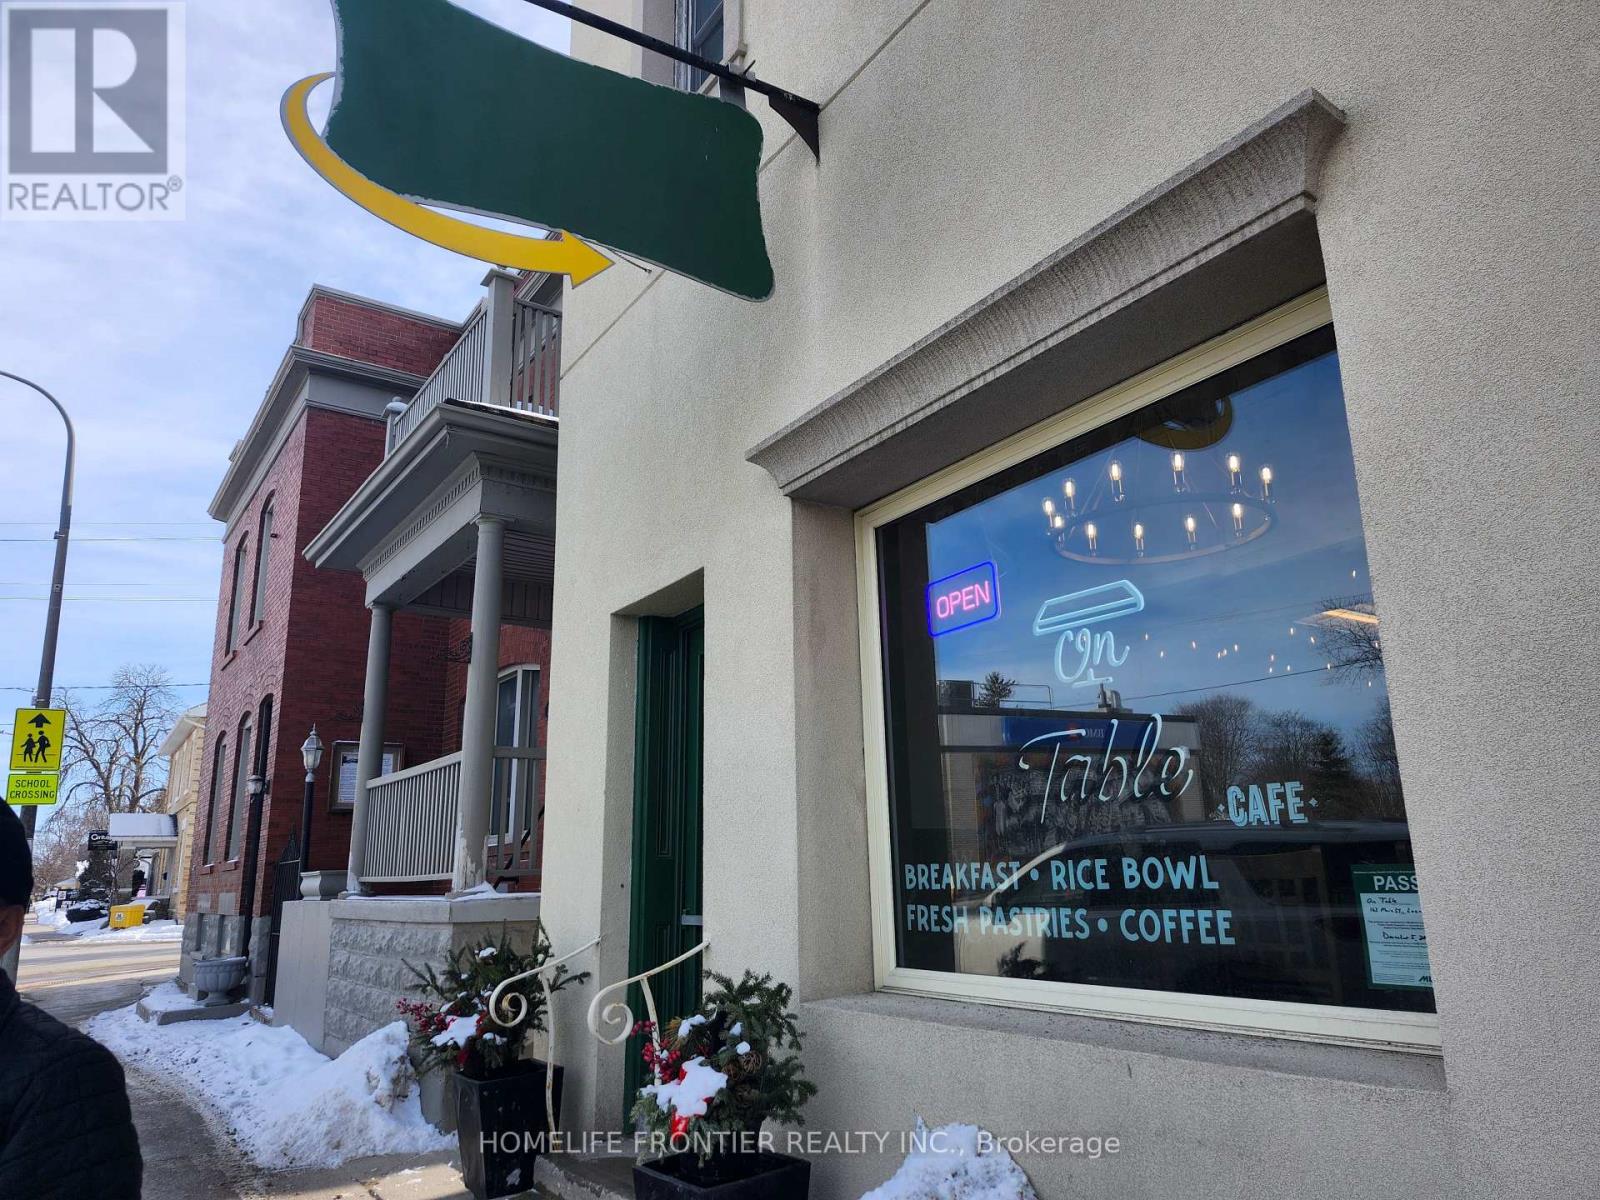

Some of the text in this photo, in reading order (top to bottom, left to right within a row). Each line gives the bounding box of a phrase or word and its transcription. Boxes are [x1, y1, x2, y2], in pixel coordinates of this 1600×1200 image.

[936, 580, 991, 618] OPEN
[1054, 627, 1131, 683] On
[15, 779, 52, 788] SCHOOL
[1018, 712, 1194, 825] Table
[10, 790, 55, 799] CROSSING
[1227, 781, 1309, 827] CAFE
[904, 855, 1220, 891] BREAKFAST RICE BOWL
[1373, 875, 1419, 891] PASS
[906, 904, 1237, 945] FRESH PASTRIES COFFEE
